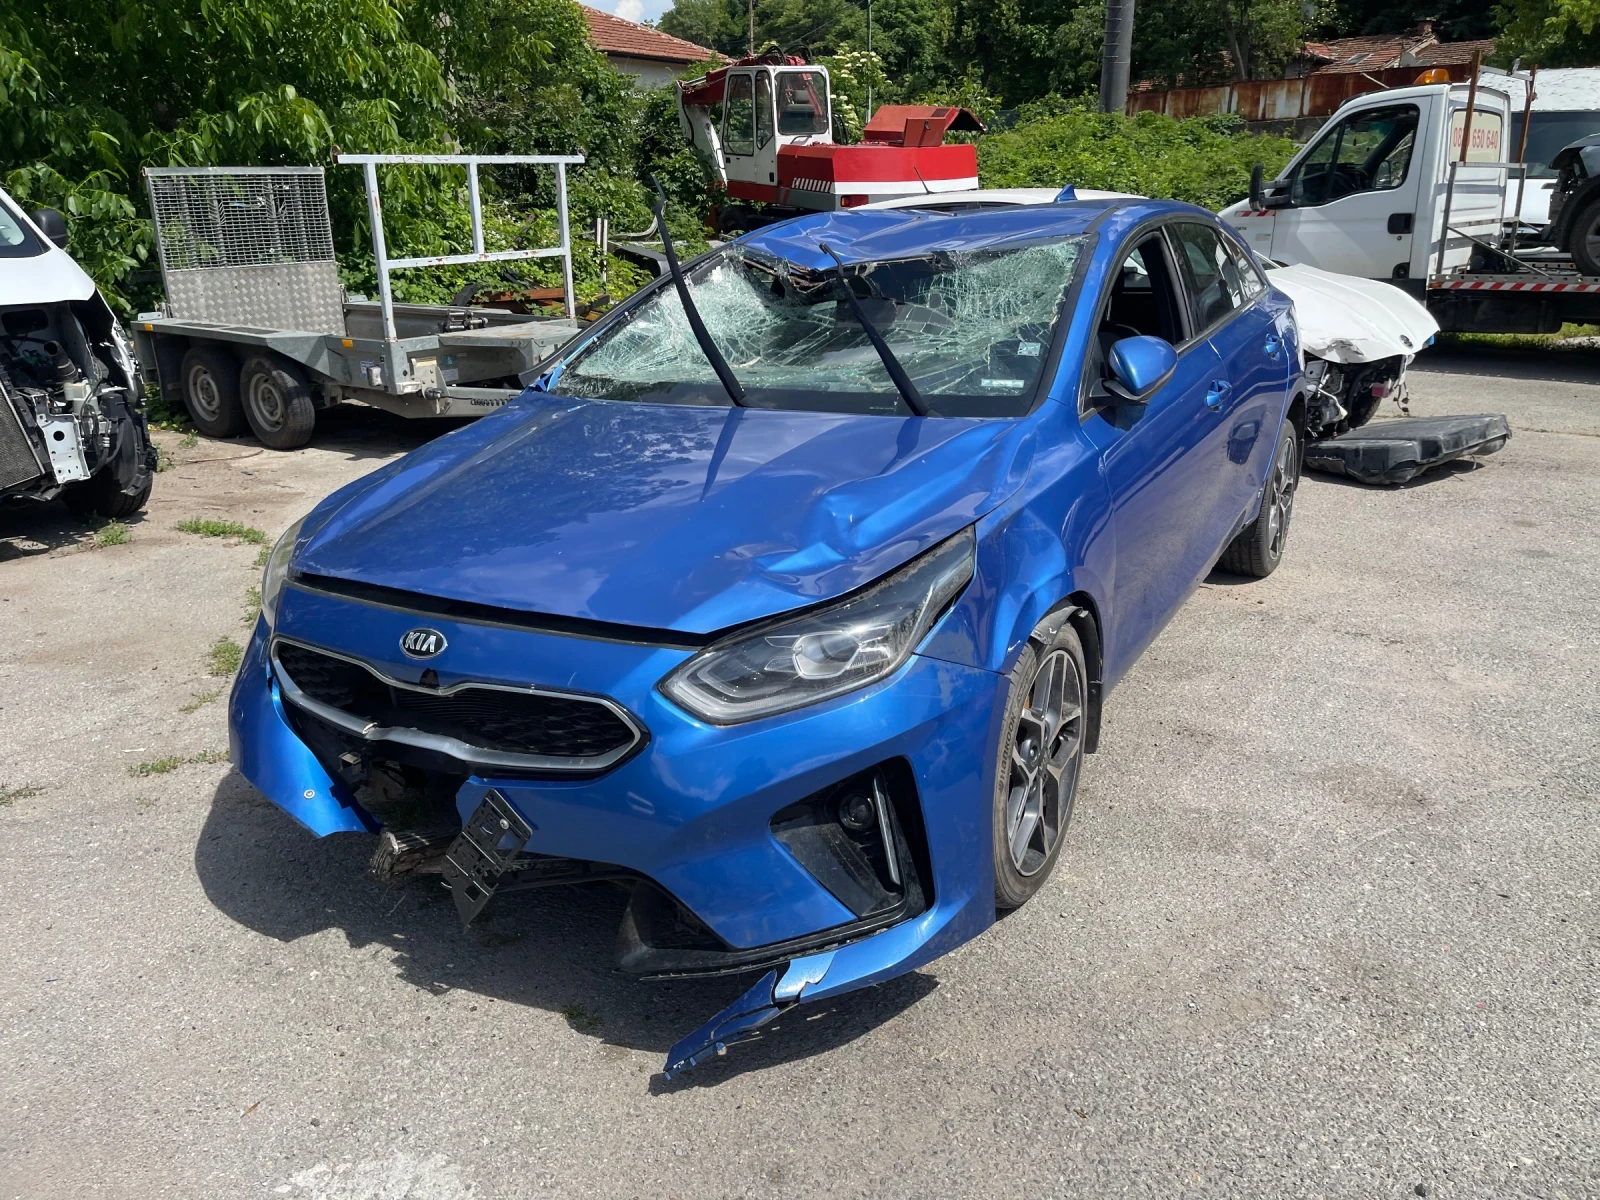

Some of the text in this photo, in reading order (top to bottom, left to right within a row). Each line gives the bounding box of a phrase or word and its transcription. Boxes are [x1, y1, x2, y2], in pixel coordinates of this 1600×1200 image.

[1453, 127, 1499, 149] 08 650 640
[404, 631, 437, 653] KIA
